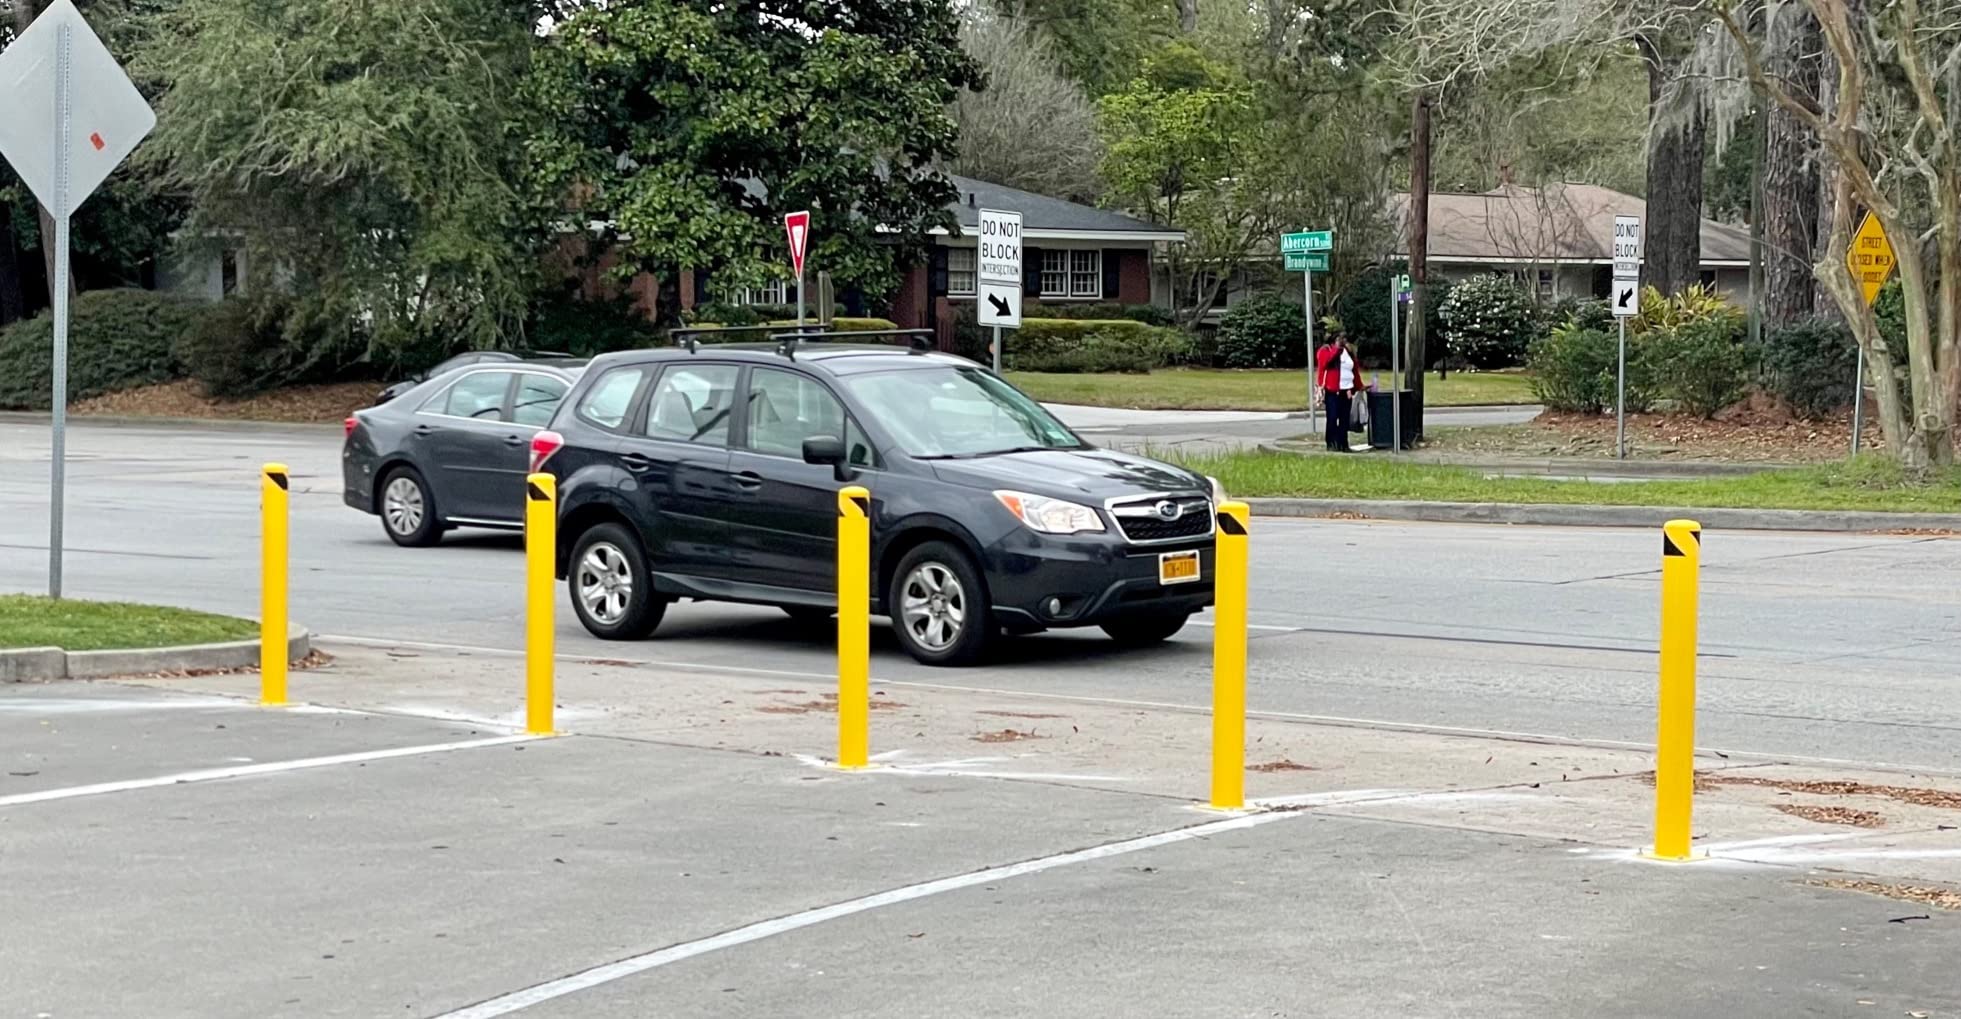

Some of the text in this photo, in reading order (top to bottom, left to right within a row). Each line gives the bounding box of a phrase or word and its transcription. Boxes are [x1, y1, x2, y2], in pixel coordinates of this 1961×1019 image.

[982, 219, 1020, 238] DO NOT
[1615, 223, 1639, 237] DO NOT
[1283, 236, 1320, 249] Abercorn
[982, 242, 1019, 261] BLOCK
[1615, 244, 1638, 258] BLOCK
[982, 263, 1019, 276] INTERSECTION
